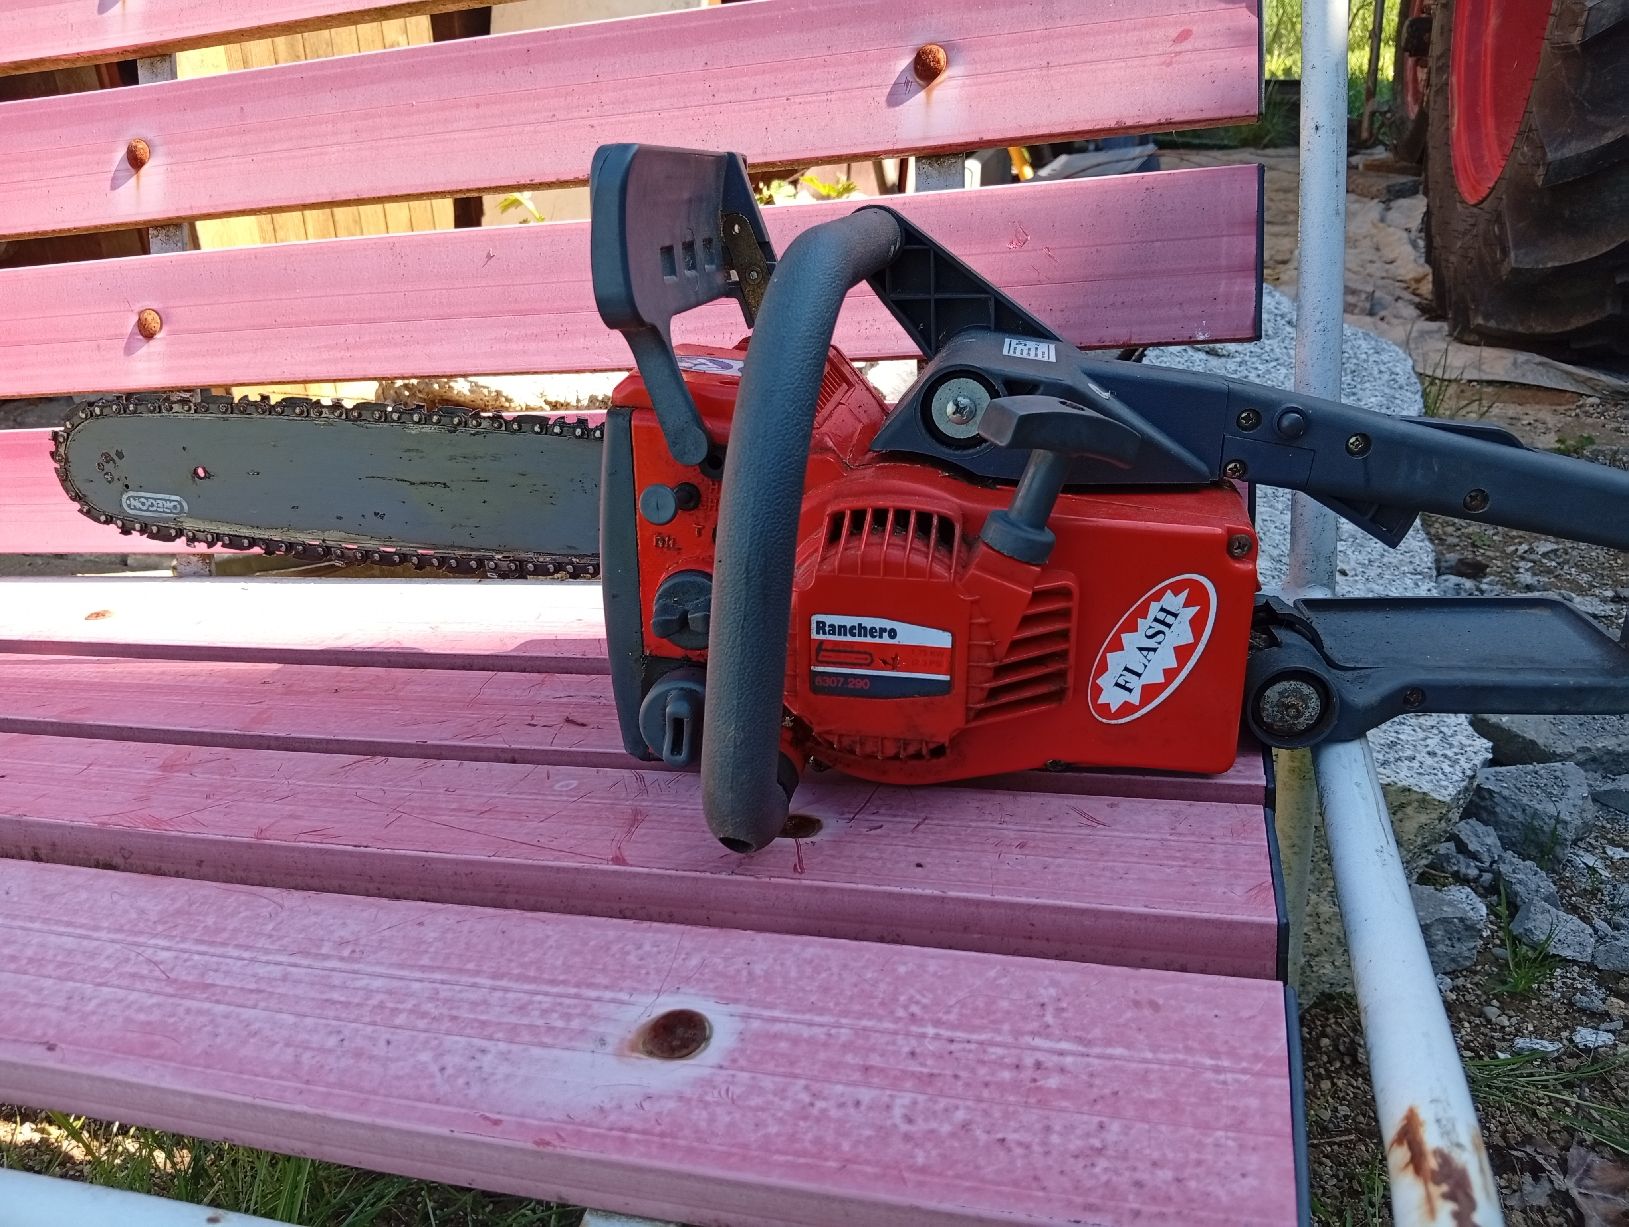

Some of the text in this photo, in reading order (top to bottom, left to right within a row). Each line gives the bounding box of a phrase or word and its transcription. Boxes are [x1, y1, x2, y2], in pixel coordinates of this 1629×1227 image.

[130, 497, 180, 513] OREGON
[815, 620, 898, 640] Ranchero
[1113, 605, 1181, 695] FLASH
